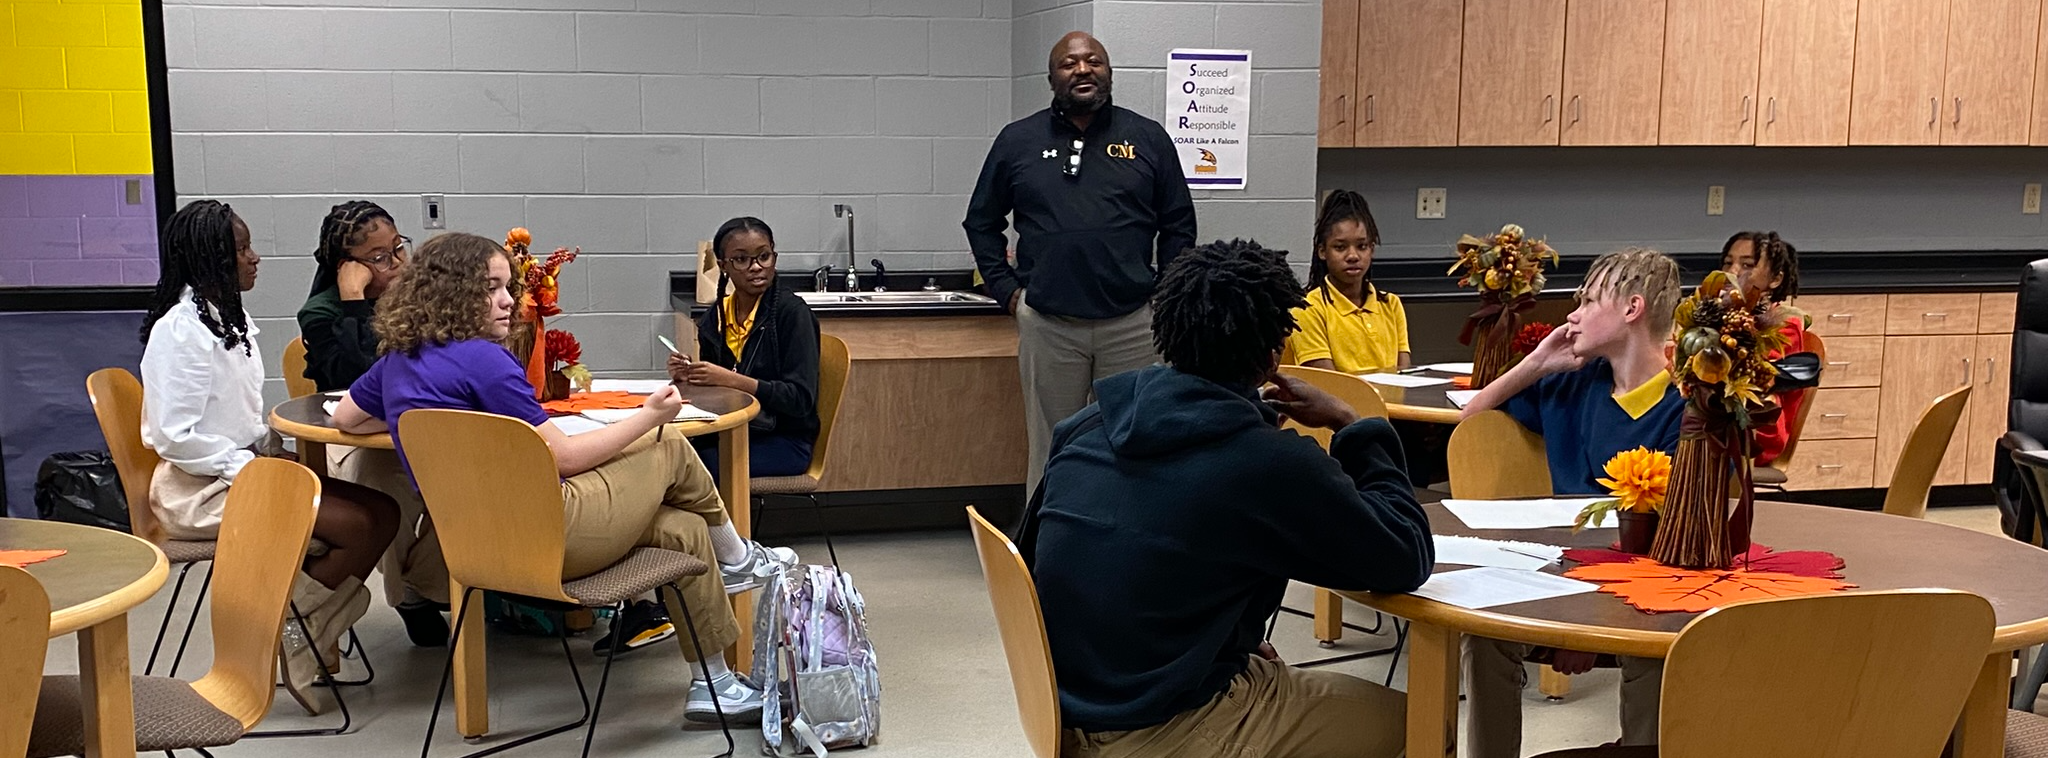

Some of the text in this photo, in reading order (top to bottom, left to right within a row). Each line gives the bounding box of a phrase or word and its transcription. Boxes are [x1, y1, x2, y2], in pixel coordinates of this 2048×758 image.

[1189, 63, 1228, 77] Succeed
[1182, 81, 1235, 97] Organized
[1187, 100, 1229, 114] Attitude
[1179, 116, 1236, 132] Responsible
[1174, 137, 1195, 145] SOAR
[1196, 137, 1209, 145] Like
